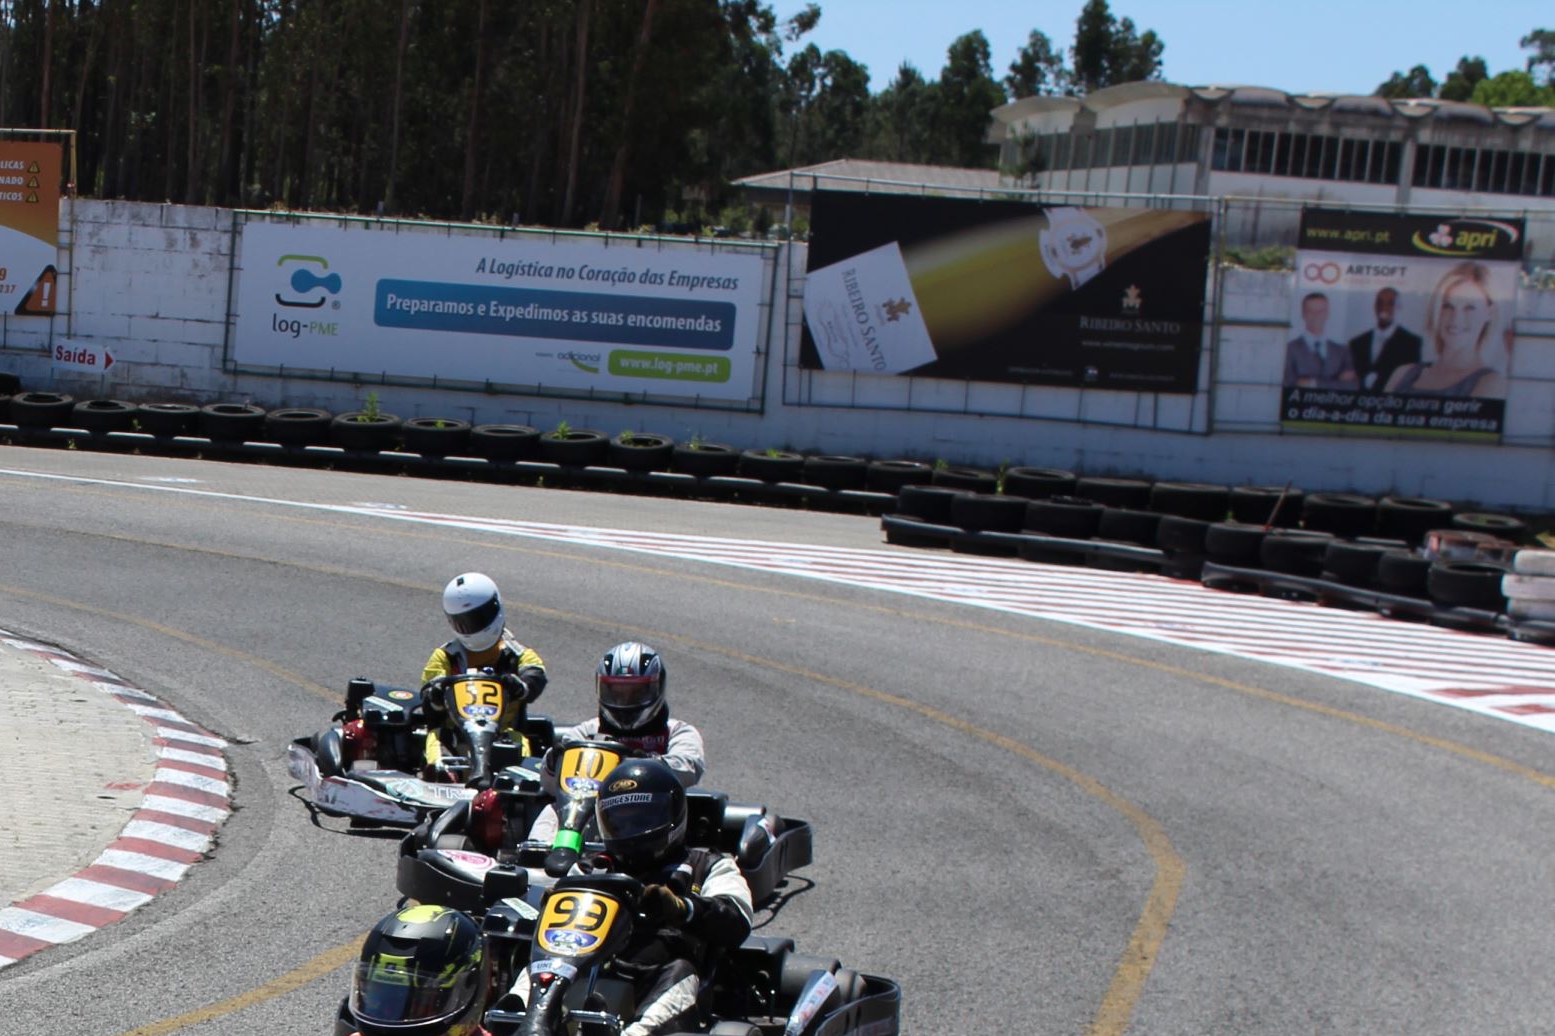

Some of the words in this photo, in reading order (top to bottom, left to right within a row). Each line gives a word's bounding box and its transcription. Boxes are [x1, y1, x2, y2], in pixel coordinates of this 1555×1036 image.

[1306, 226, 1391, 243] www.apri.pt
[1455, 228, 1499, 250] apri
[475, 257, 487, 274] A
[490, 258, 553, 281] Logística
[556, 266, 576, 280] no
[578, 264, 636, 287] Coração
[640, 268, 664, 286] das
[668, 272, 739, 291] Empresas
[1346, 264, 1408, 278] ARTSOFT
[272, 312, 339, 339] log-PME
[386, 293, 474, 316] Preparamos
[477, 303, 486, 316] e
[490, 300, 569, 323] Expedimos
[571, 309, 589, 324] as
[591, 310, 624, 326] suas
[627, 311, 722, 333] encomendas
[55, 344, 96, 365] Saída
[620, 356, 718, 375] www.log-pme.pt
[1288, 389, 1300, 401] A
[1303, 391, 1354, 406] melhor
[1357, 394, 1403, 411] opção
[1405, 397, 1440, 412] para
[1442, 397, 1483, 414] gerir
[1302, 405, 1370, 423] dia-a-dia
[1373, 410, 1393, 424] da
[1397, 414, 1426, 426] sua
[1429, 416, 1499, 431] empresa
[548, 895, 608, 932] 93
